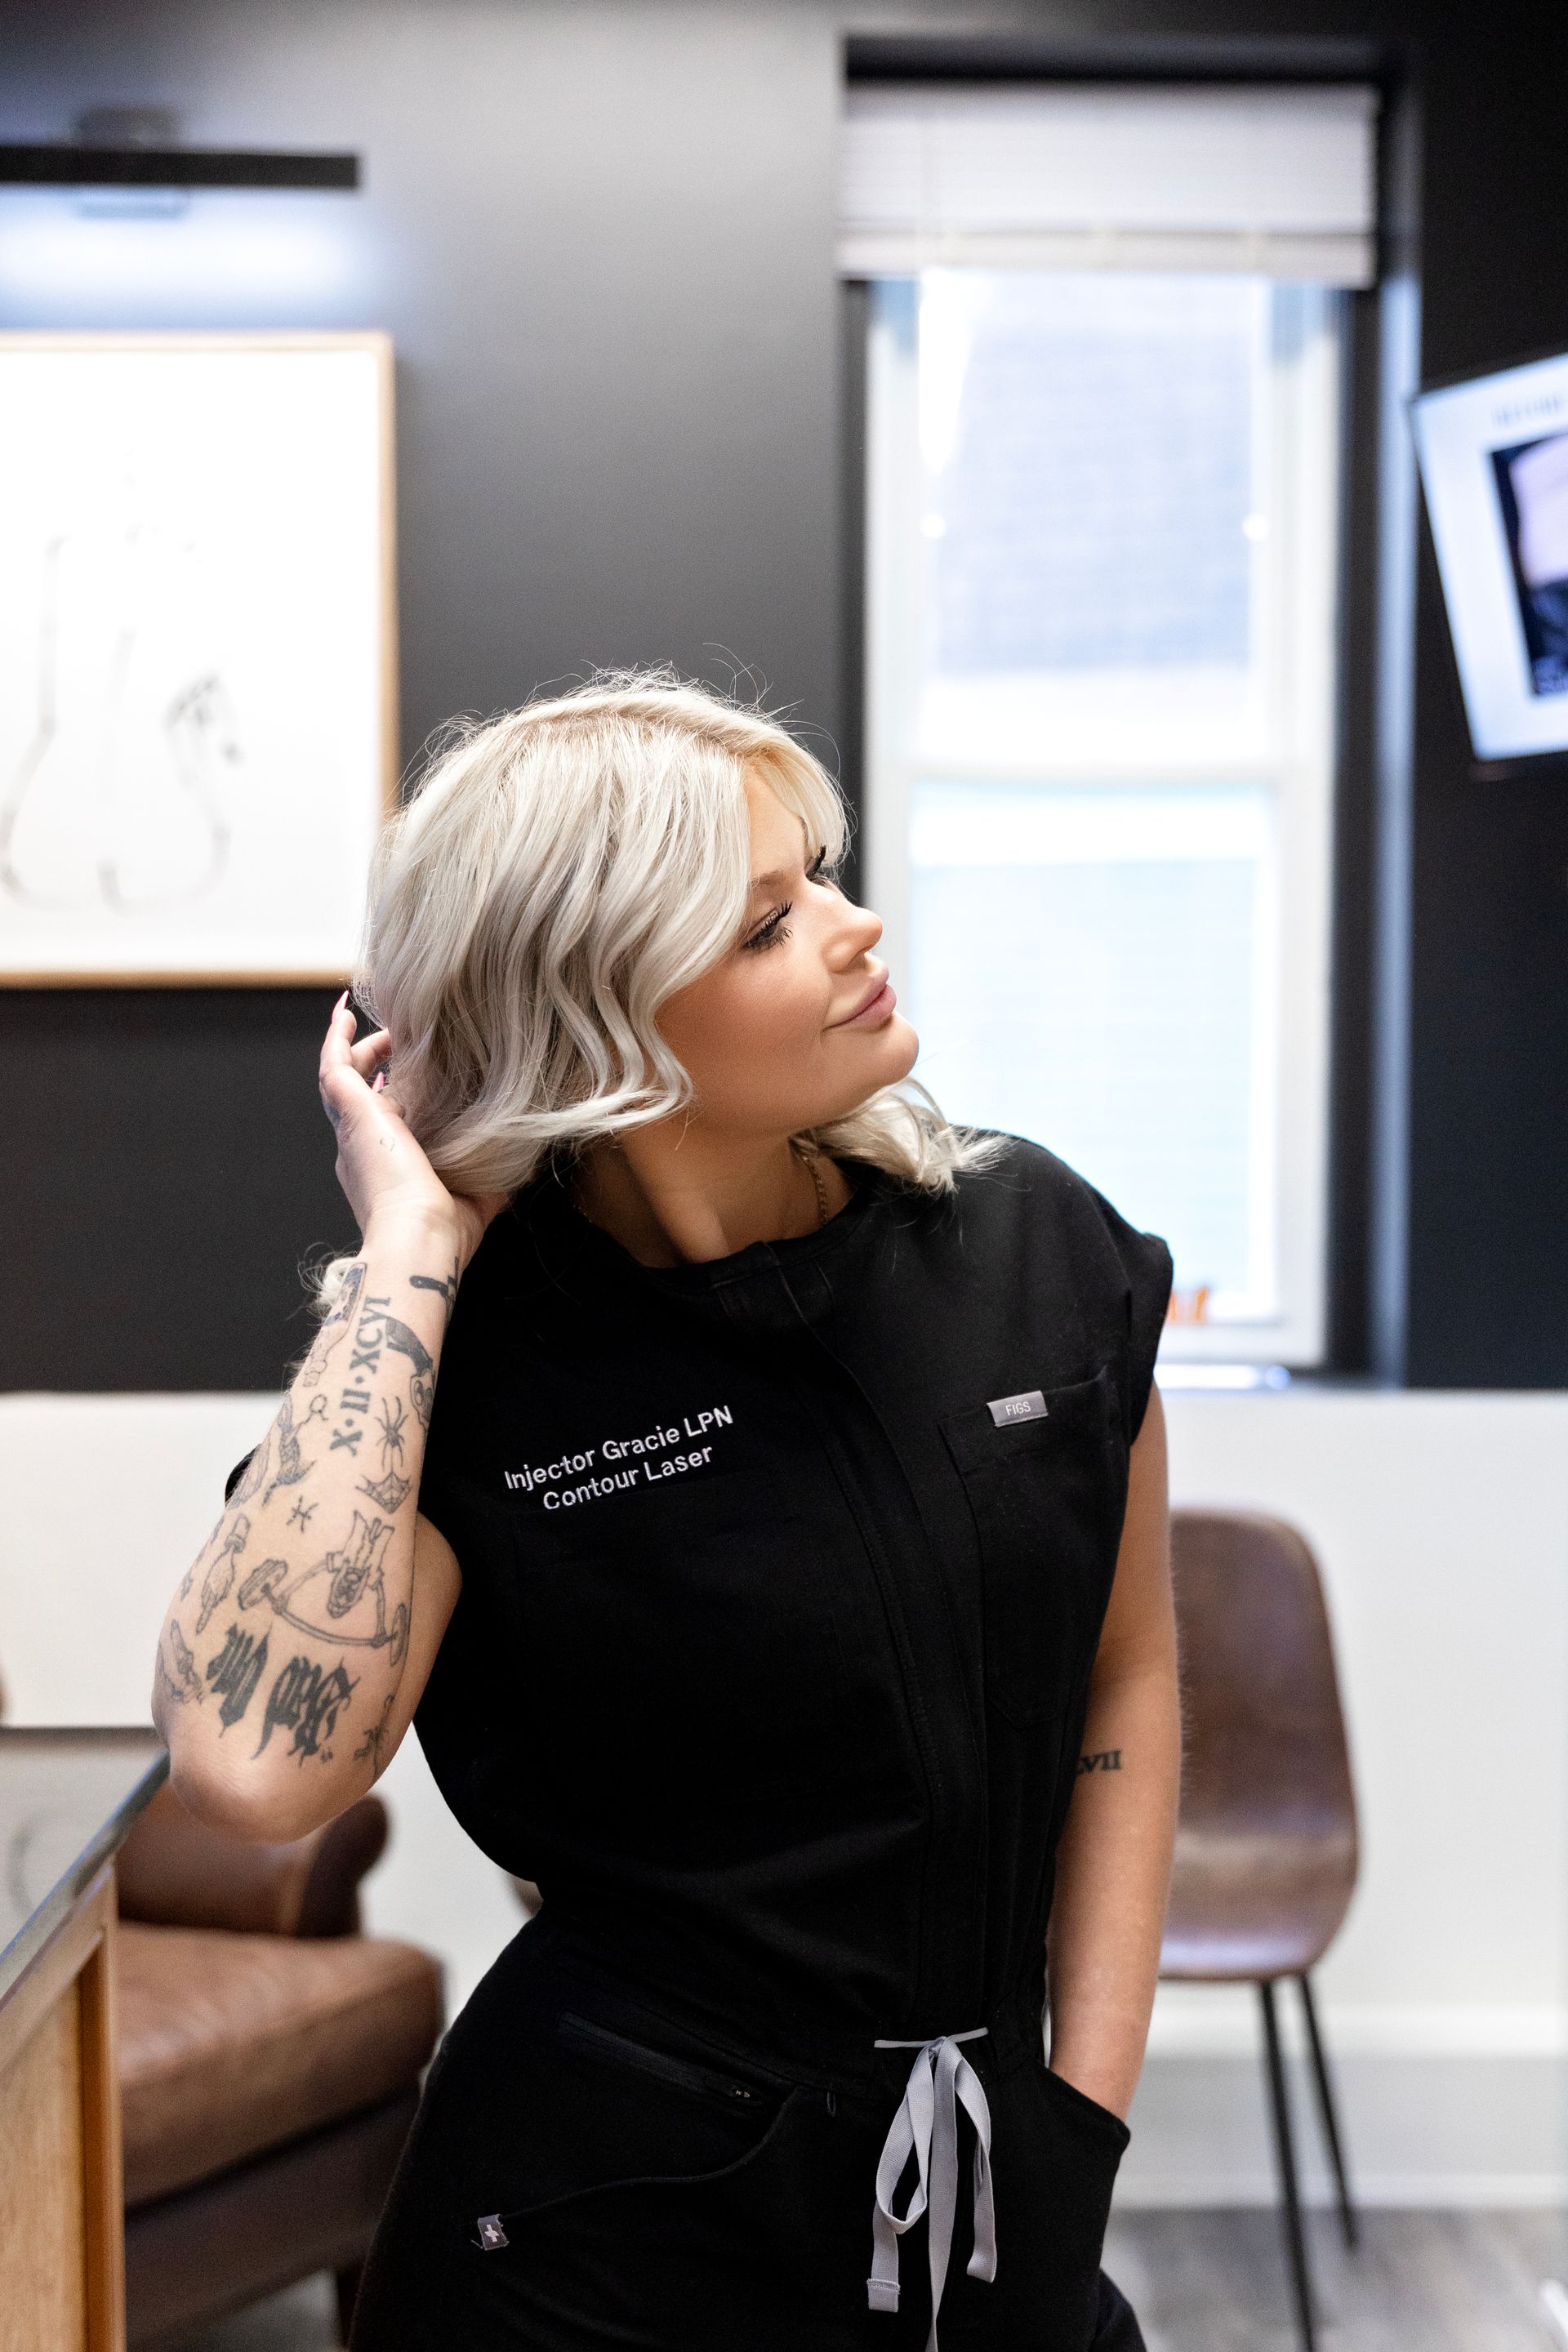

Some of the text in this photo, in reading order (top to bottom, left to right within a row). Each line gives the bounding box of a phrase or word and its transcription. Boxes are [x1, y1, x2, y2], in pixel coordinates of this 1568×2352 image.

[1005, 1401, 1031, 1415] FIGS
[504, 1405, 733, 1491] Injector Gracie LPN
[543, 1446, 713, 1510] Contour Laser
